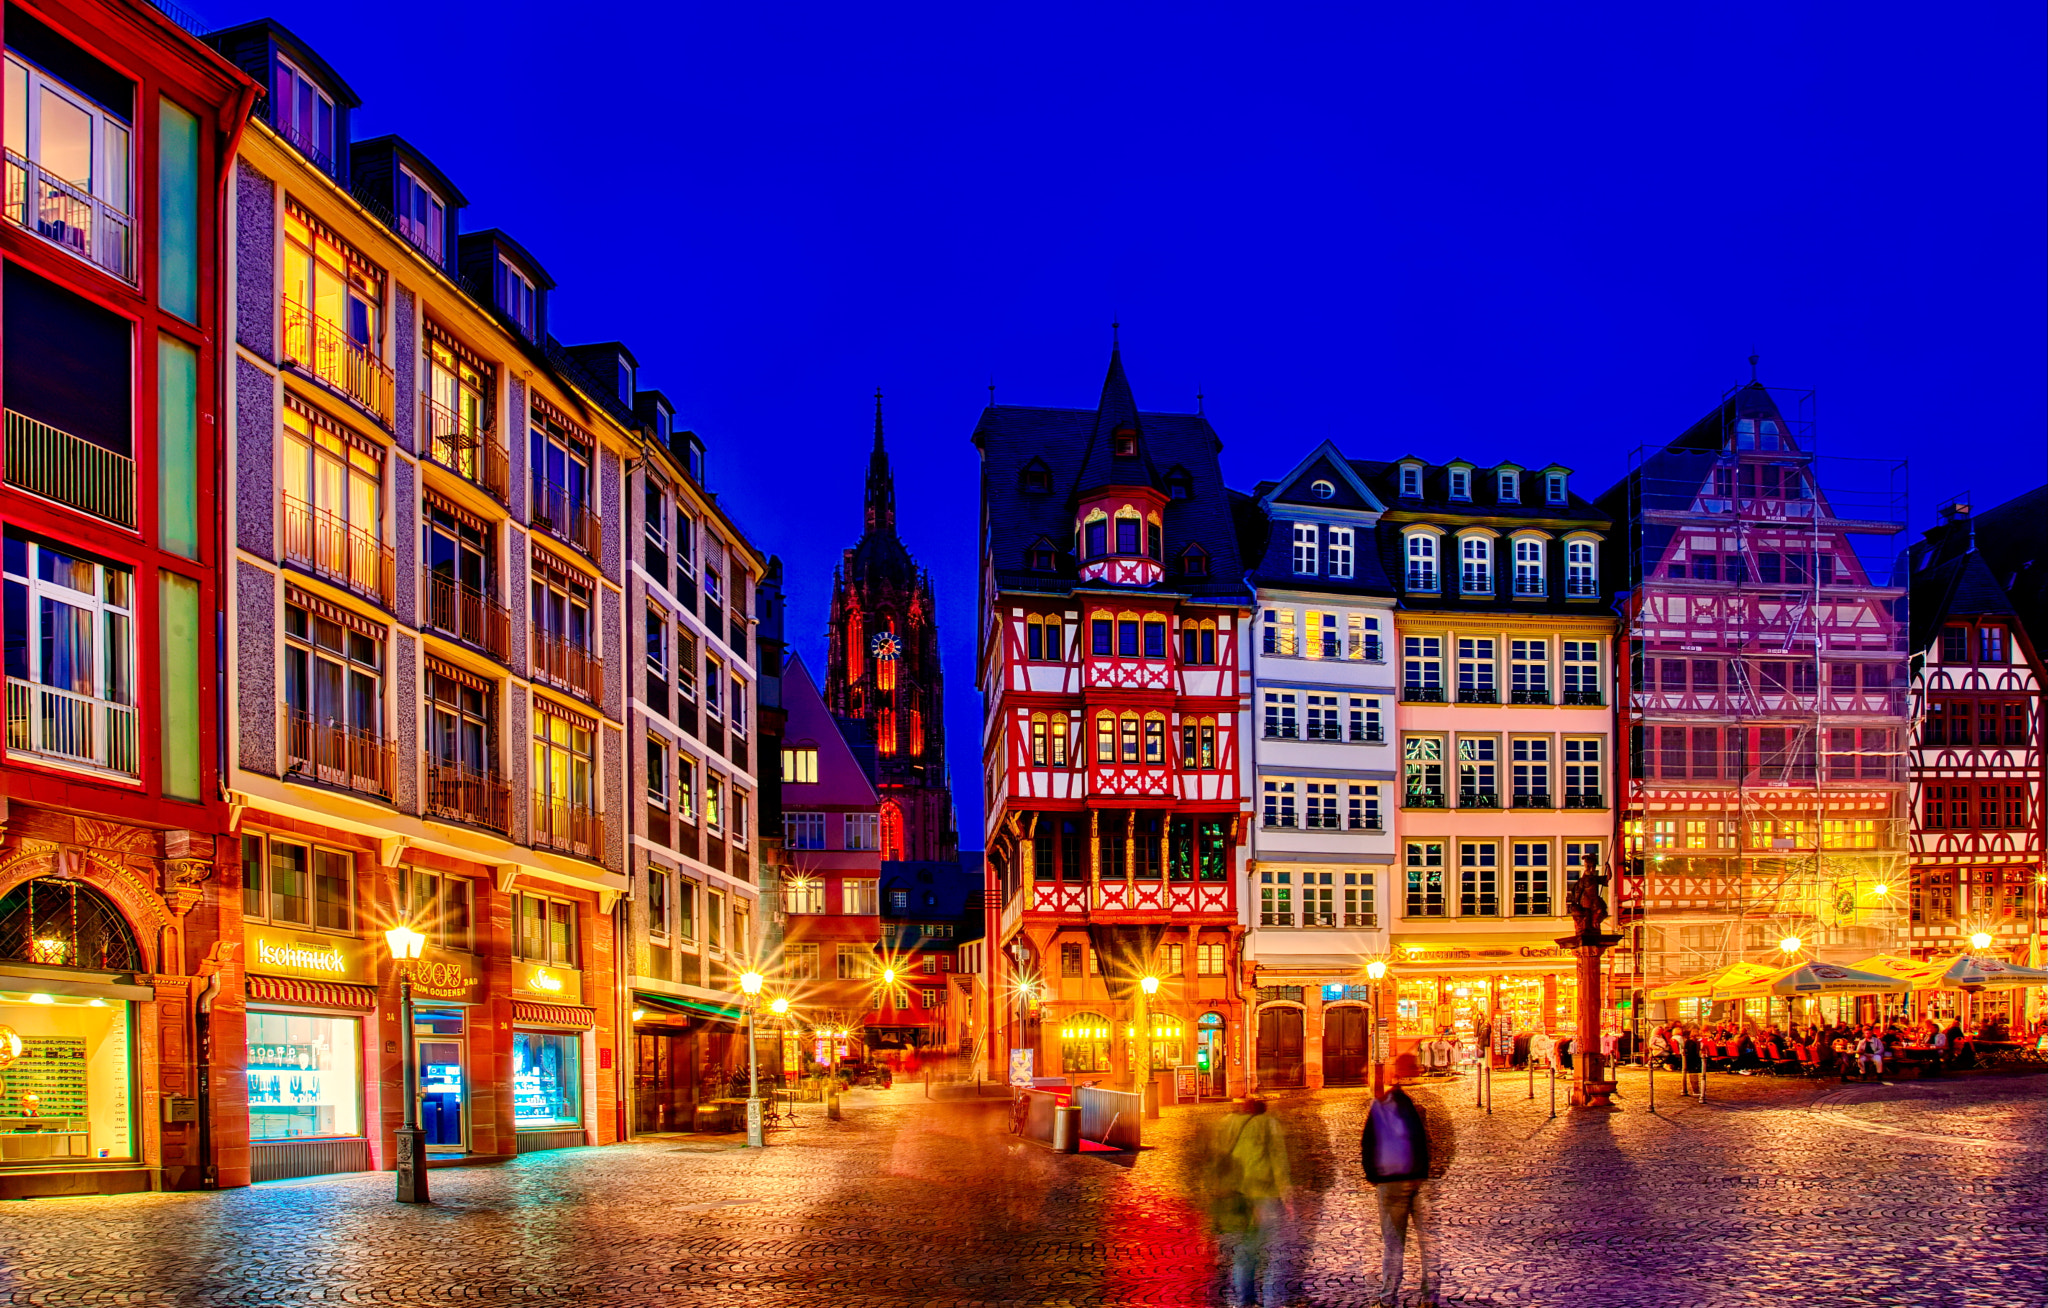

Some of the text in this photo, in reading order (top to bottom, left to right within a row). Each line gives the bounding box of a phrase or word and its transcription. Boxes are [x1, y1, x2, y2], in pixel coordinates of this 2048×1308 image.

[1519, 946, 1577, 958] Gesche
[413, 982, 429, 994] ZUM
[430, 987, 466, 997] GOLDENEN
[463, 977, 478, 986] RAD
[386, 1013, 395, 1021] 34
